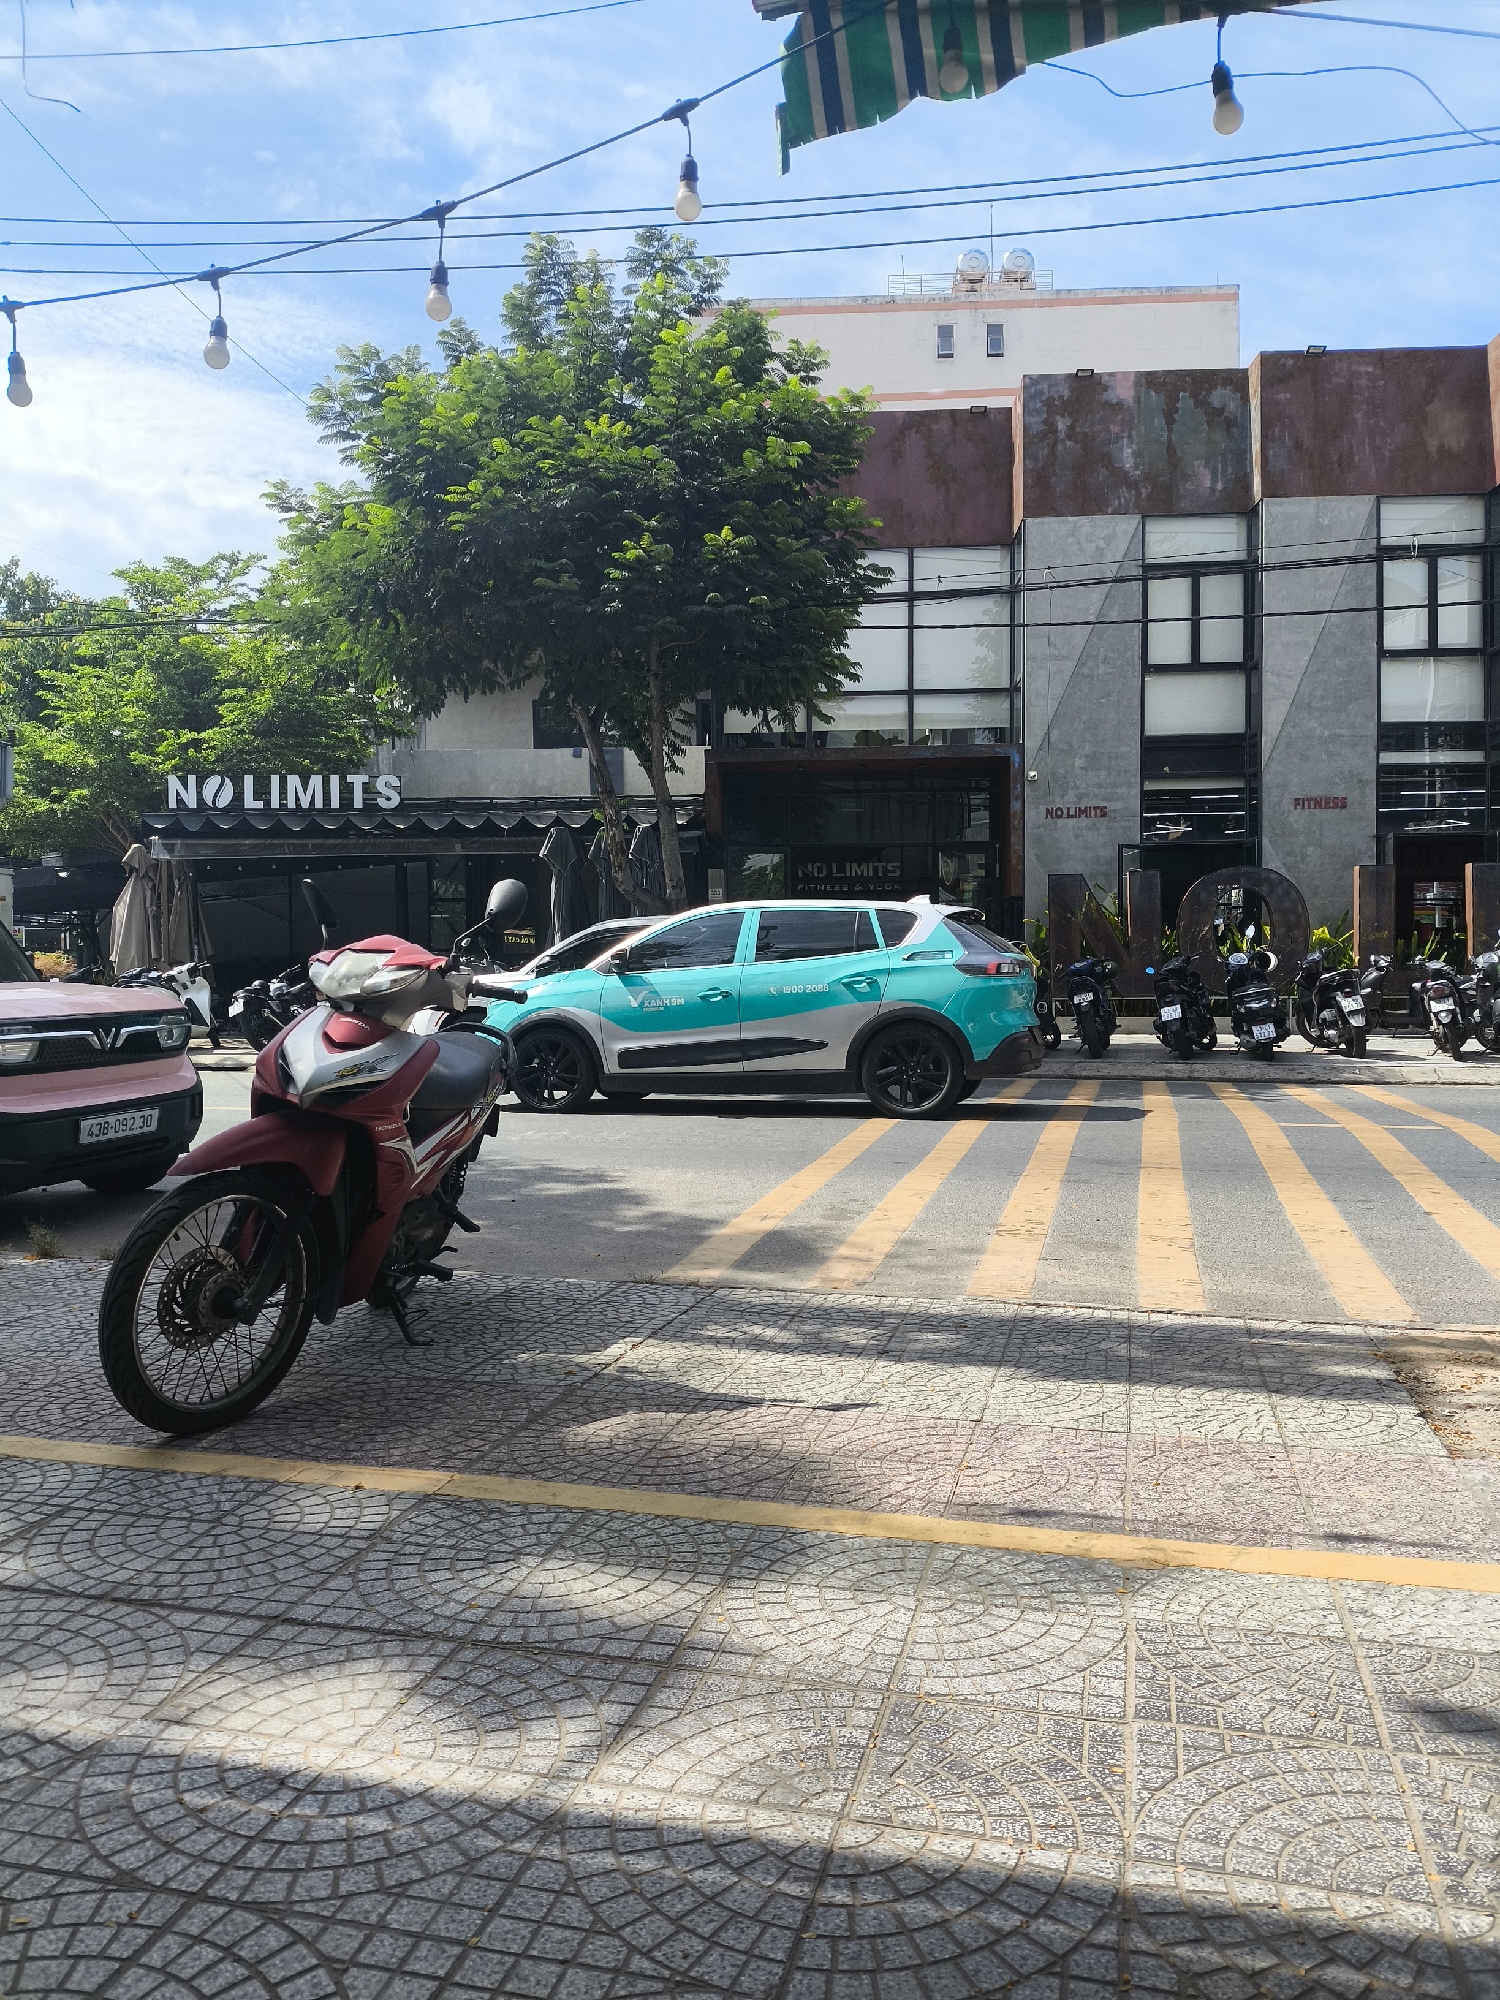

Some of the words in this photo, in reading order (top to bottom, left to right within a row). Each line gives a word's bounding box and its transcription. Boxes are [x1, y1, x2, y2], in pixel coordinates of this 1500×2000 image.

[243, 774, 401, 809] LIMITS
[1293, 796, 1348, 810] FITNESS
[1045, 806, 1065, 819] NO
[1066, 805, 1108, 819] LIMITS
[798, 862, 827, 878] NO
[832, 862, 901, 877] LIMITS
[781, 984, 804, 994] 1900
[805, 983, 829, 993] 2088
[643, 998, 670, 1008] XANH
[671, 997, 685, 1006] SM
[87, 1113, 153, 1138] 43B-092.30
[374, 1122, 402, 1132] HONDA
